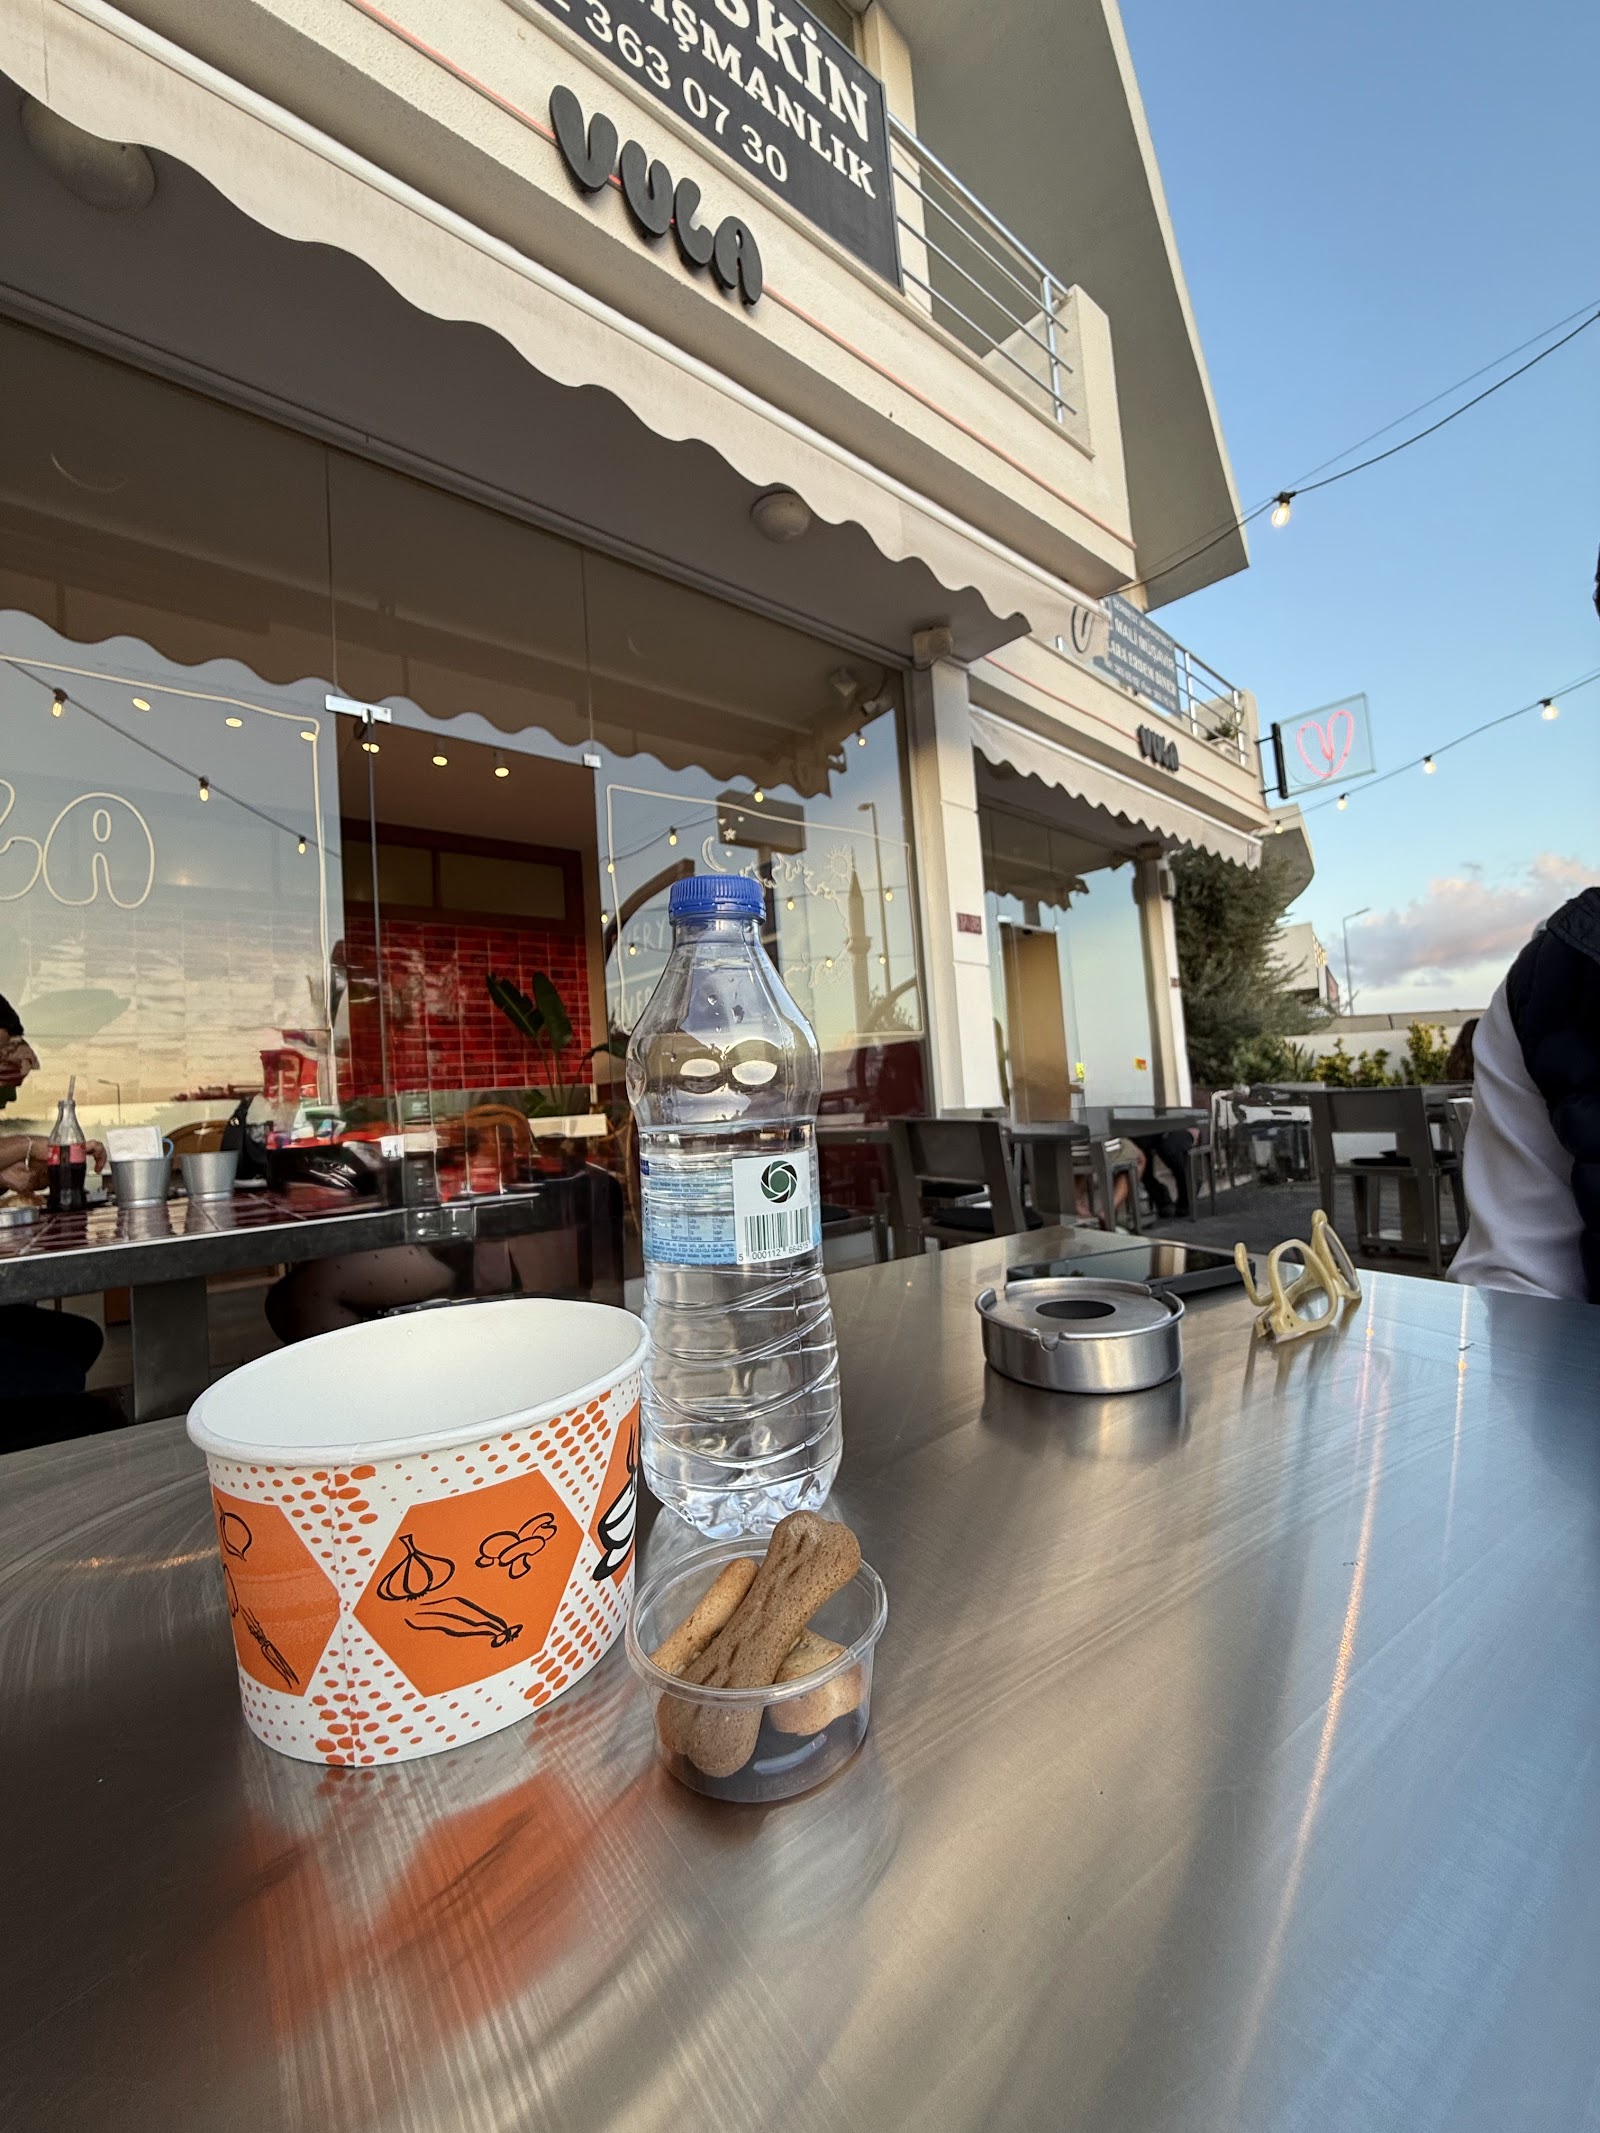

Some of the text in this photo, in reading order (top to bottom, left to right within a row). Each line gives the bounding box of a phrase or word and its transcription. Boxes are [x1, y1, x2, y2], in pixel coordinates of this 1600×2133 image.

[585, 0, 788, 183] 363 07 30
[637, 0, 877, 199] IŞMANLIK
[549, 85, 763, 306] VULA
[752, 1248, 781, 1260] 000112
